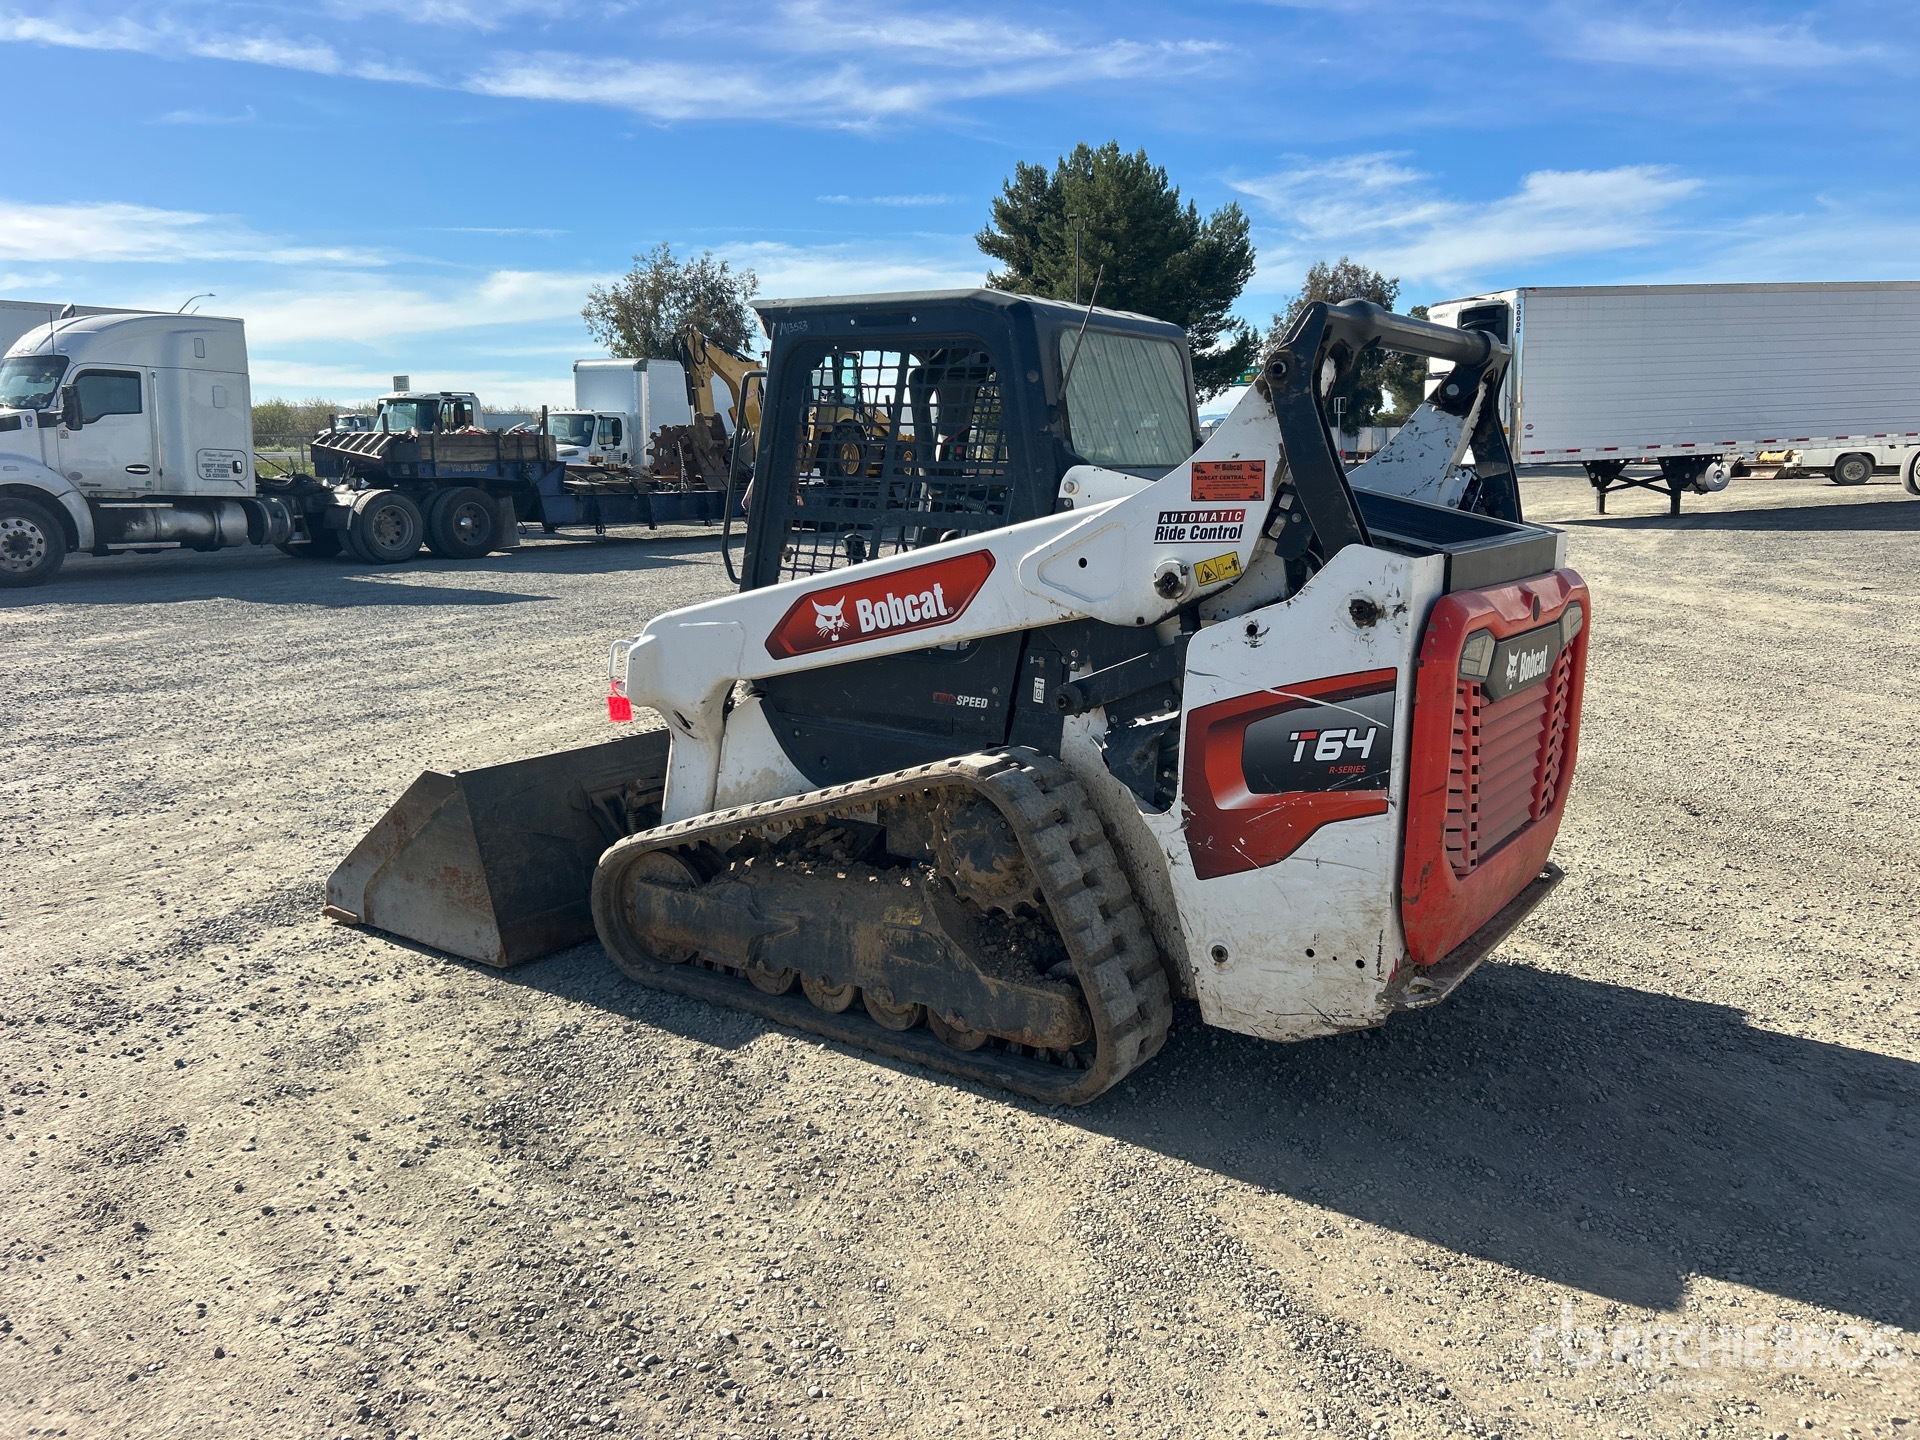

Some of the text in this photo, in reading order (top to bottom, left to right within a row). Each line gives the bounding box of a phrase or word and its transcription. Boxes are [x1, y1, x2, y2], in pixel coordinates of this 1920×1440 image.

[1221, 463, 1243, 471] Bobcat
[1160, 511, 1242, 523] AUTOMATIC
[1154, 524, 1244, 541] Ride Control
[855, 582, 948, 633] Bobcat
[1518, 644, 1548, 683] Bobcat
[956, 695, 988, 709] SPEED
[1289, 727, 1377, 762] T64
[1328, 765, 1367, 775] R-SERIES
